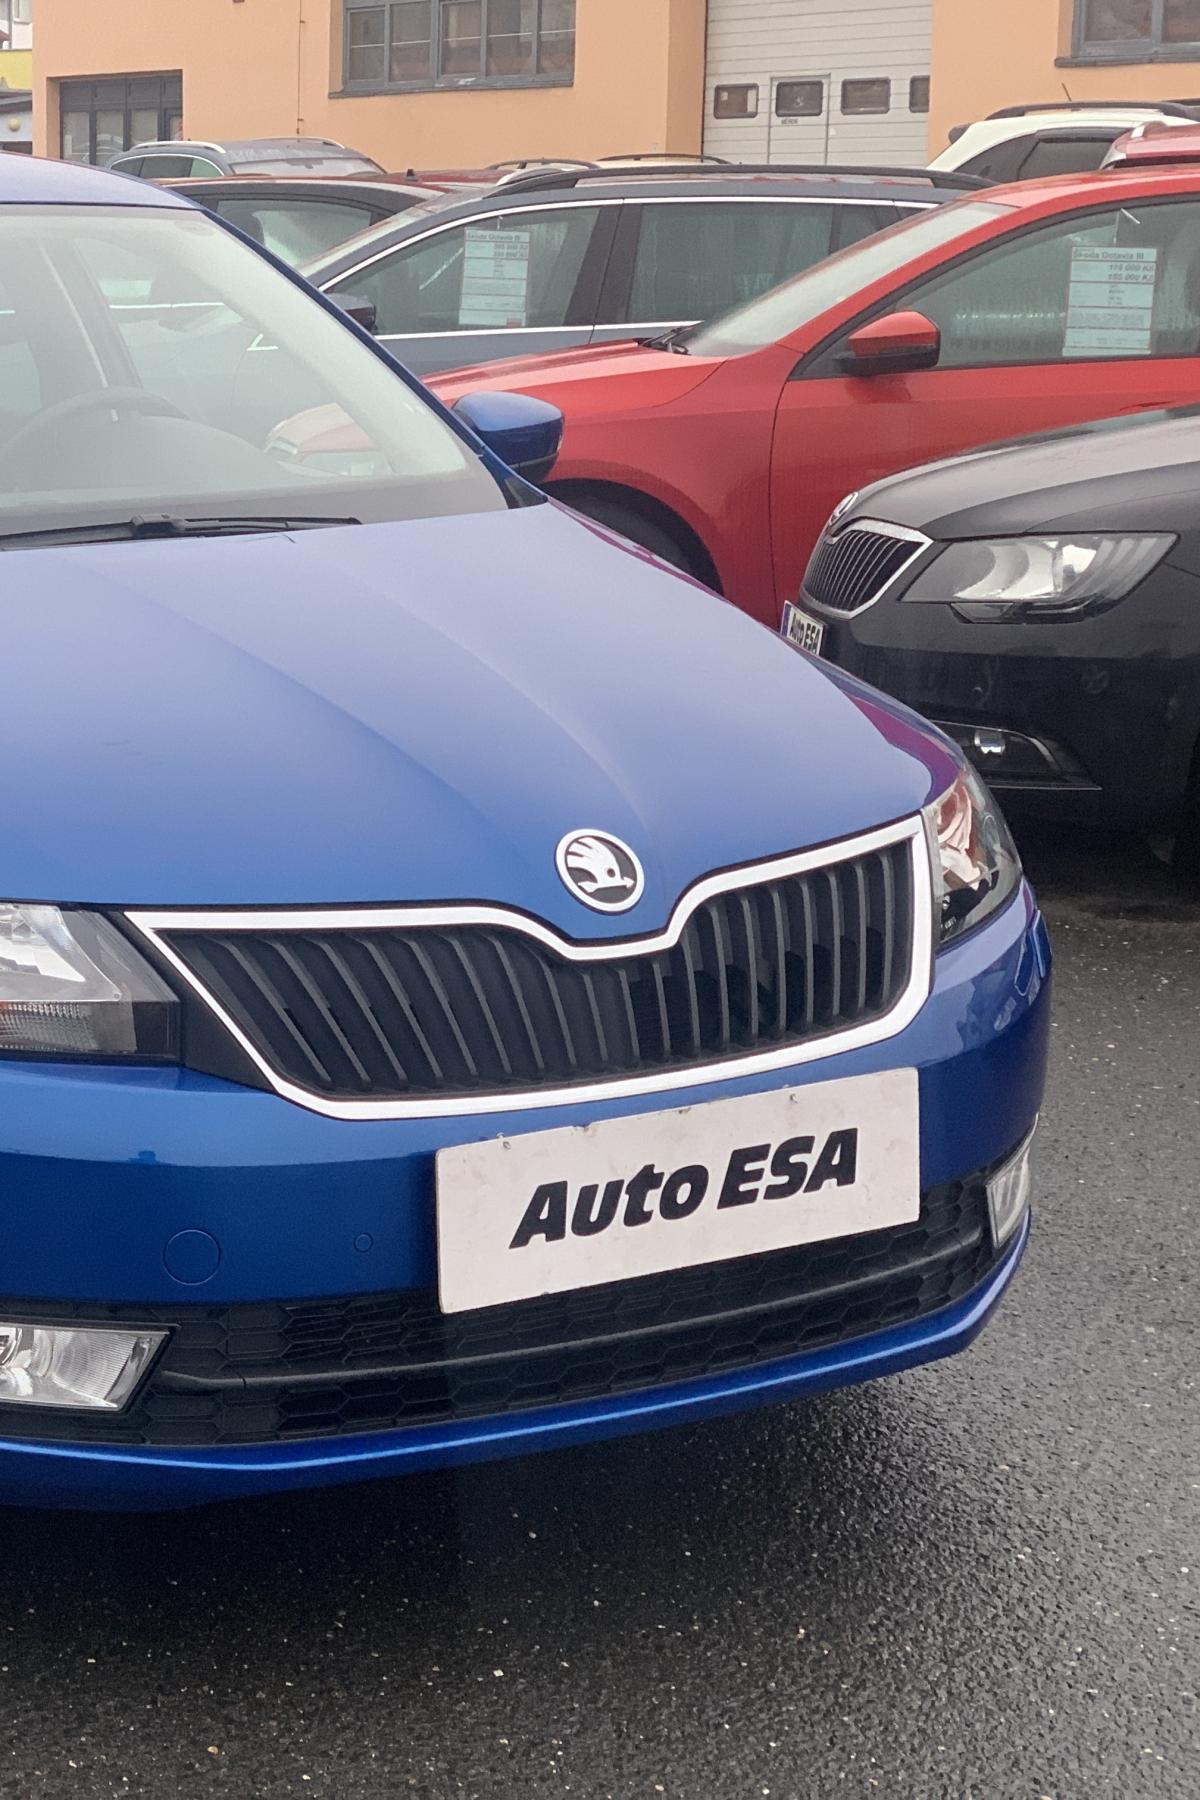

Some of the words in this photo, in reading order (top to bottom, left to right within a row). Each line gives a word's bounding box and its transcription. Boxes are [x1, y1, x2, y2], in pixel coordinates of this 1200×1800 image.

[804, 623, 820, 654] ESA
[509, 1163, 710, 1249] Auto
[716, 1127, 859, 1210] ESA
